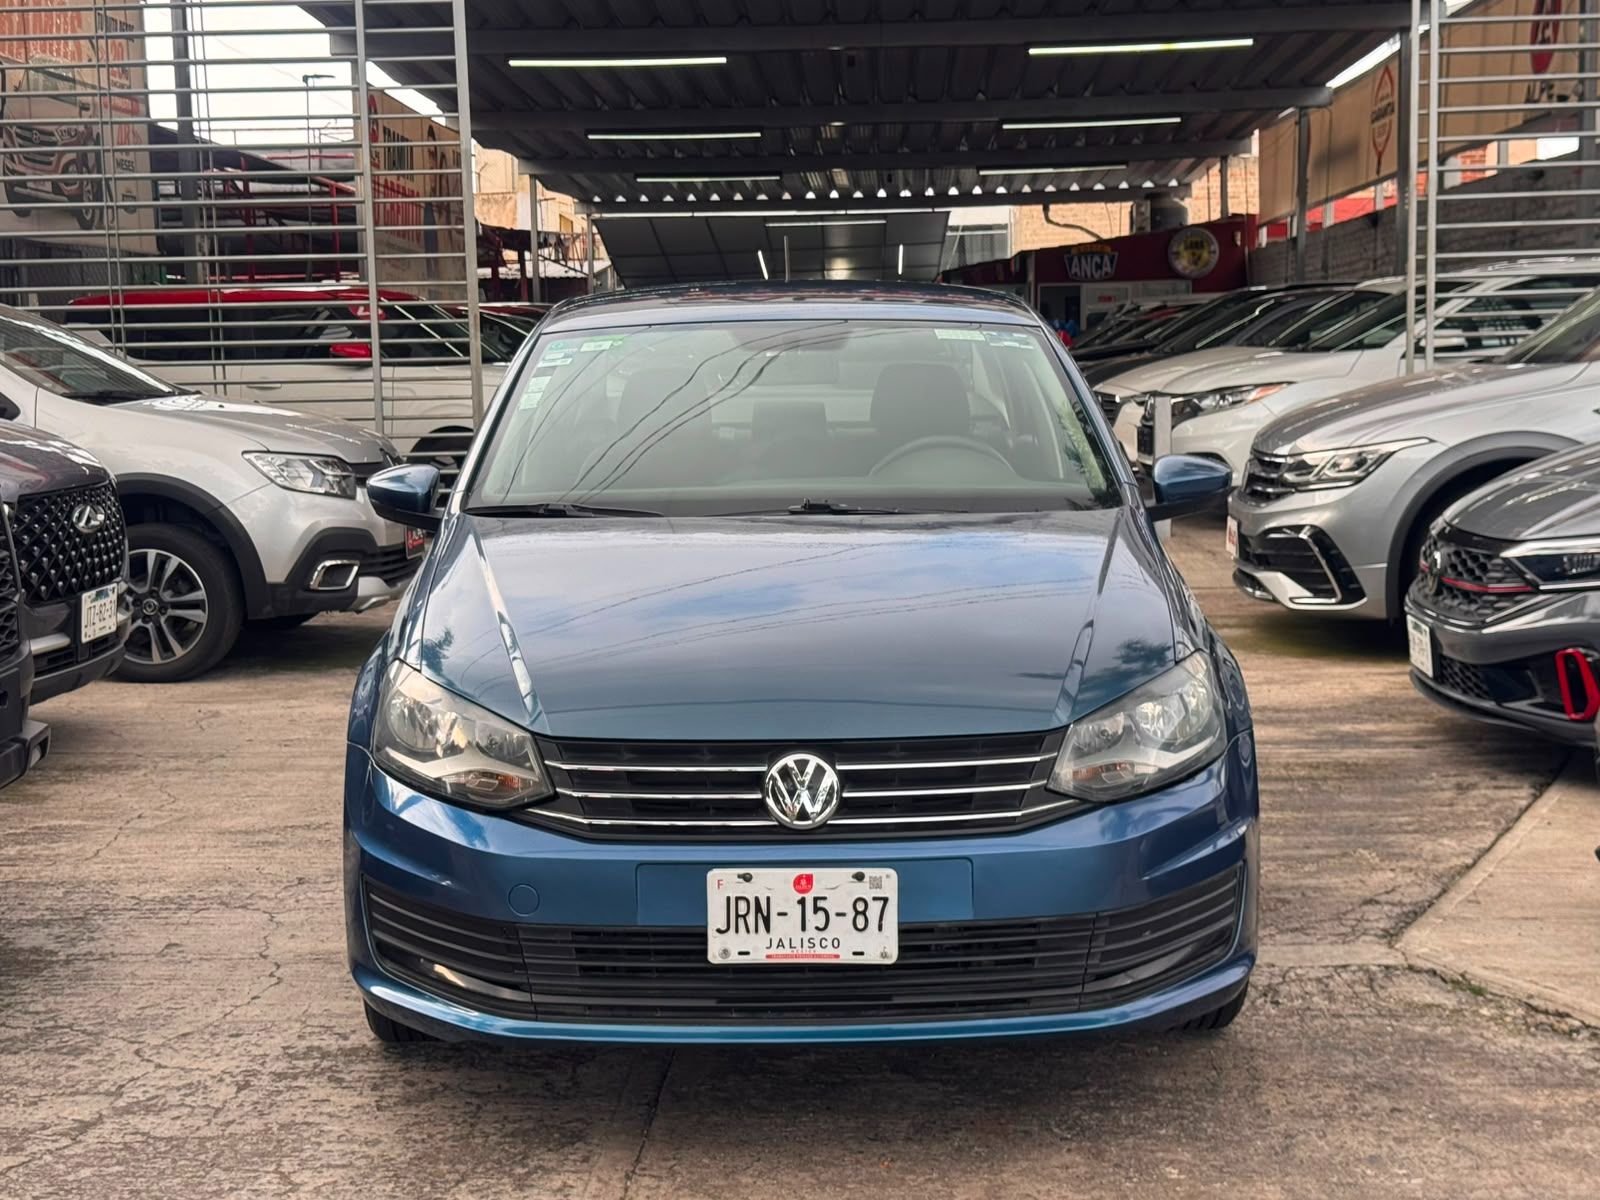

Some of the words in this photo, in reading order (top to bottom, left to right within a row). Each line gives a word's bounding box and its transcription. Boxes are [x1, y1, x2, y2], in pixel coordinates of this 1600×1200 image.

[116, 158, 135, 172] MESES
[717, 879, 724, 890] F
[715, 896, 890, 934] JRN-15-87
[766, 937, 841, 950] JALISCO
